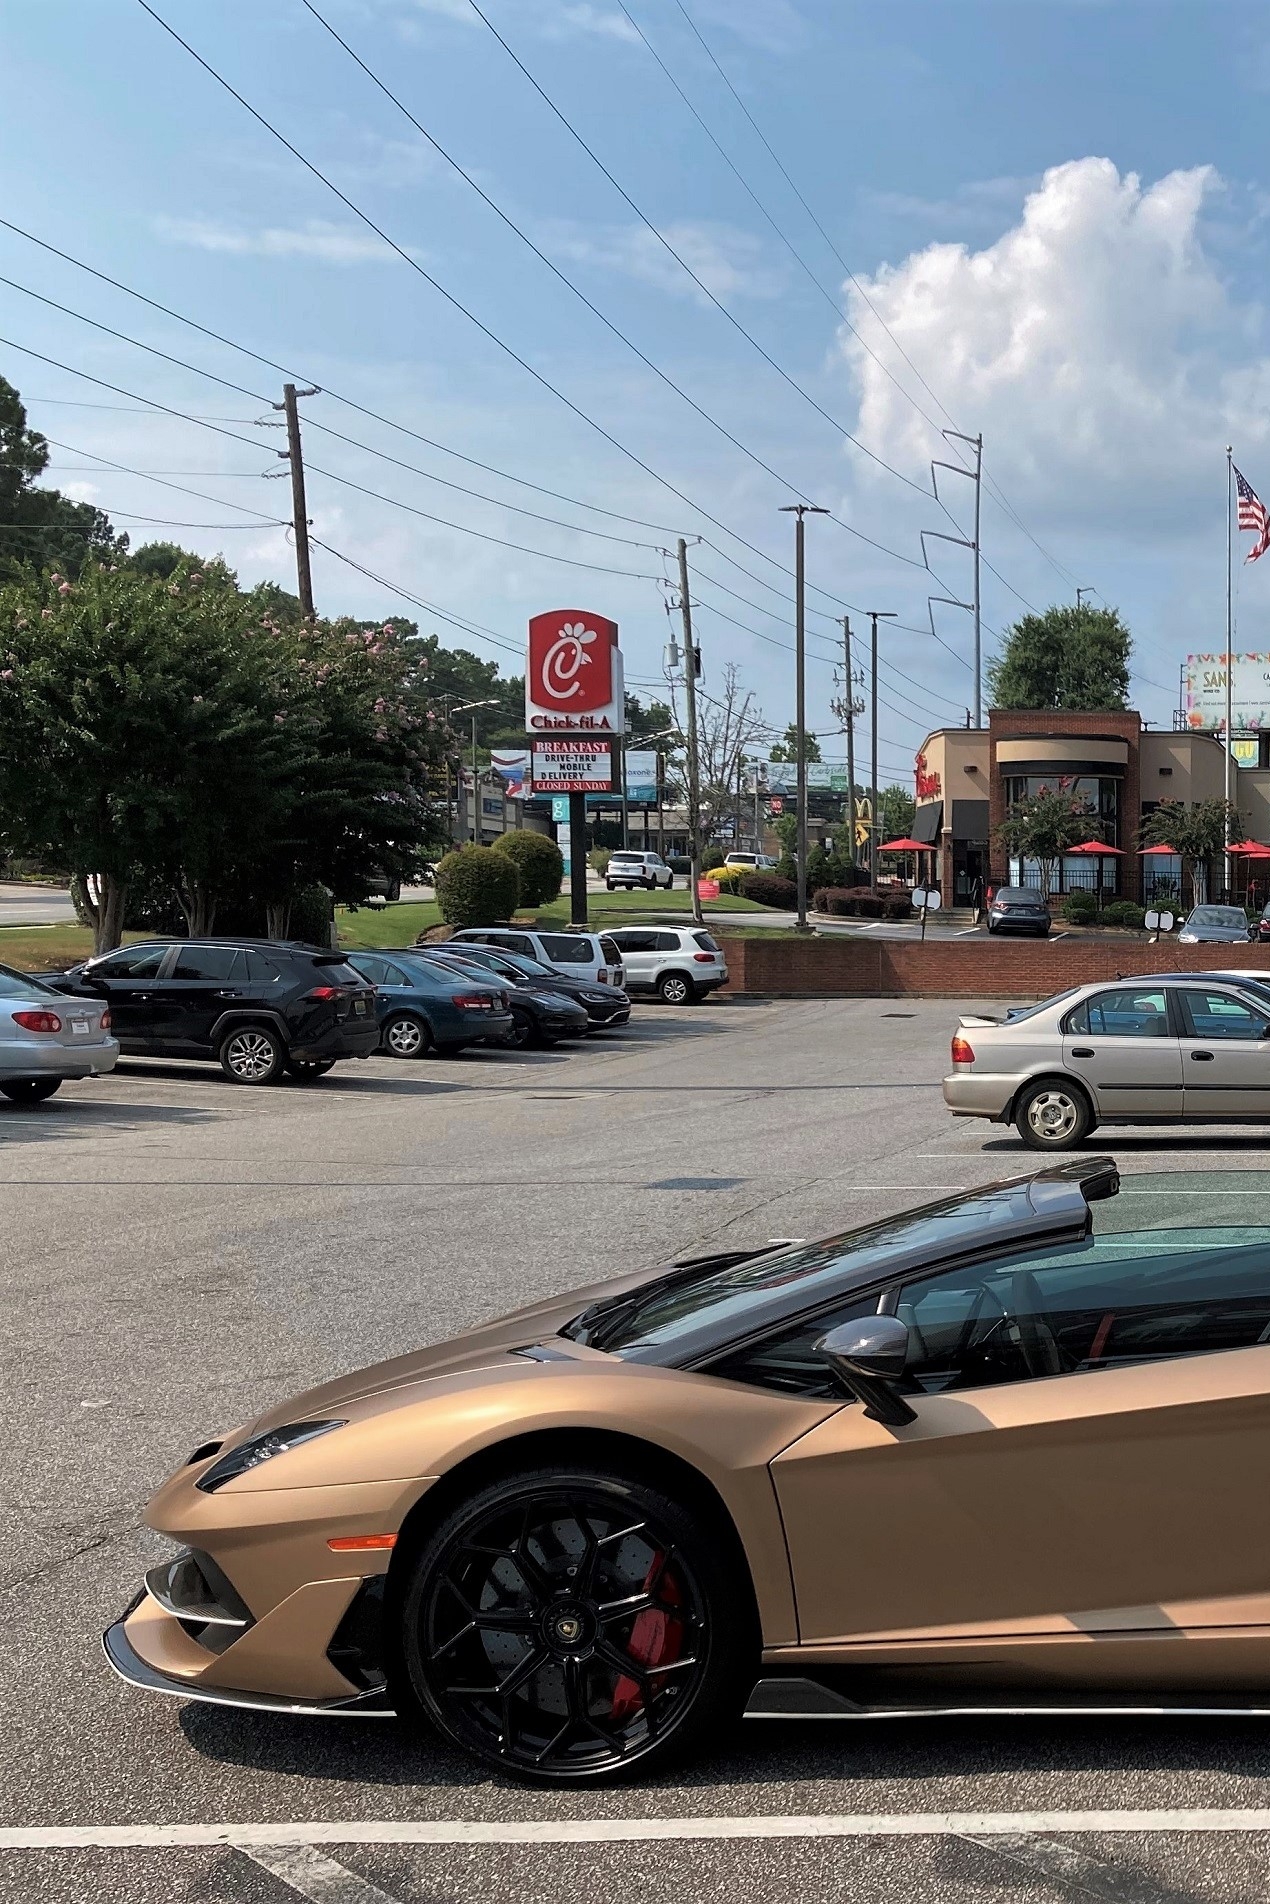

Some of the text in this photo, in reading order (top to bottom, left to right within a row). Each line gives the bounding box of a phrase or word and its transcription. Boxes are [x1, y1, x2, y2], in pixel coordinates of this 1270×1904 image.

[530, 714, 612, 730] Chick-fil-A
[536, 741, 608, 753] BREAKFAST
[544, 754, 597, 762] DRIVE-THRU
[560, 763, 592, 771] MOBILE
[536, 781, 607, 791] CLOSED SUNDAY
